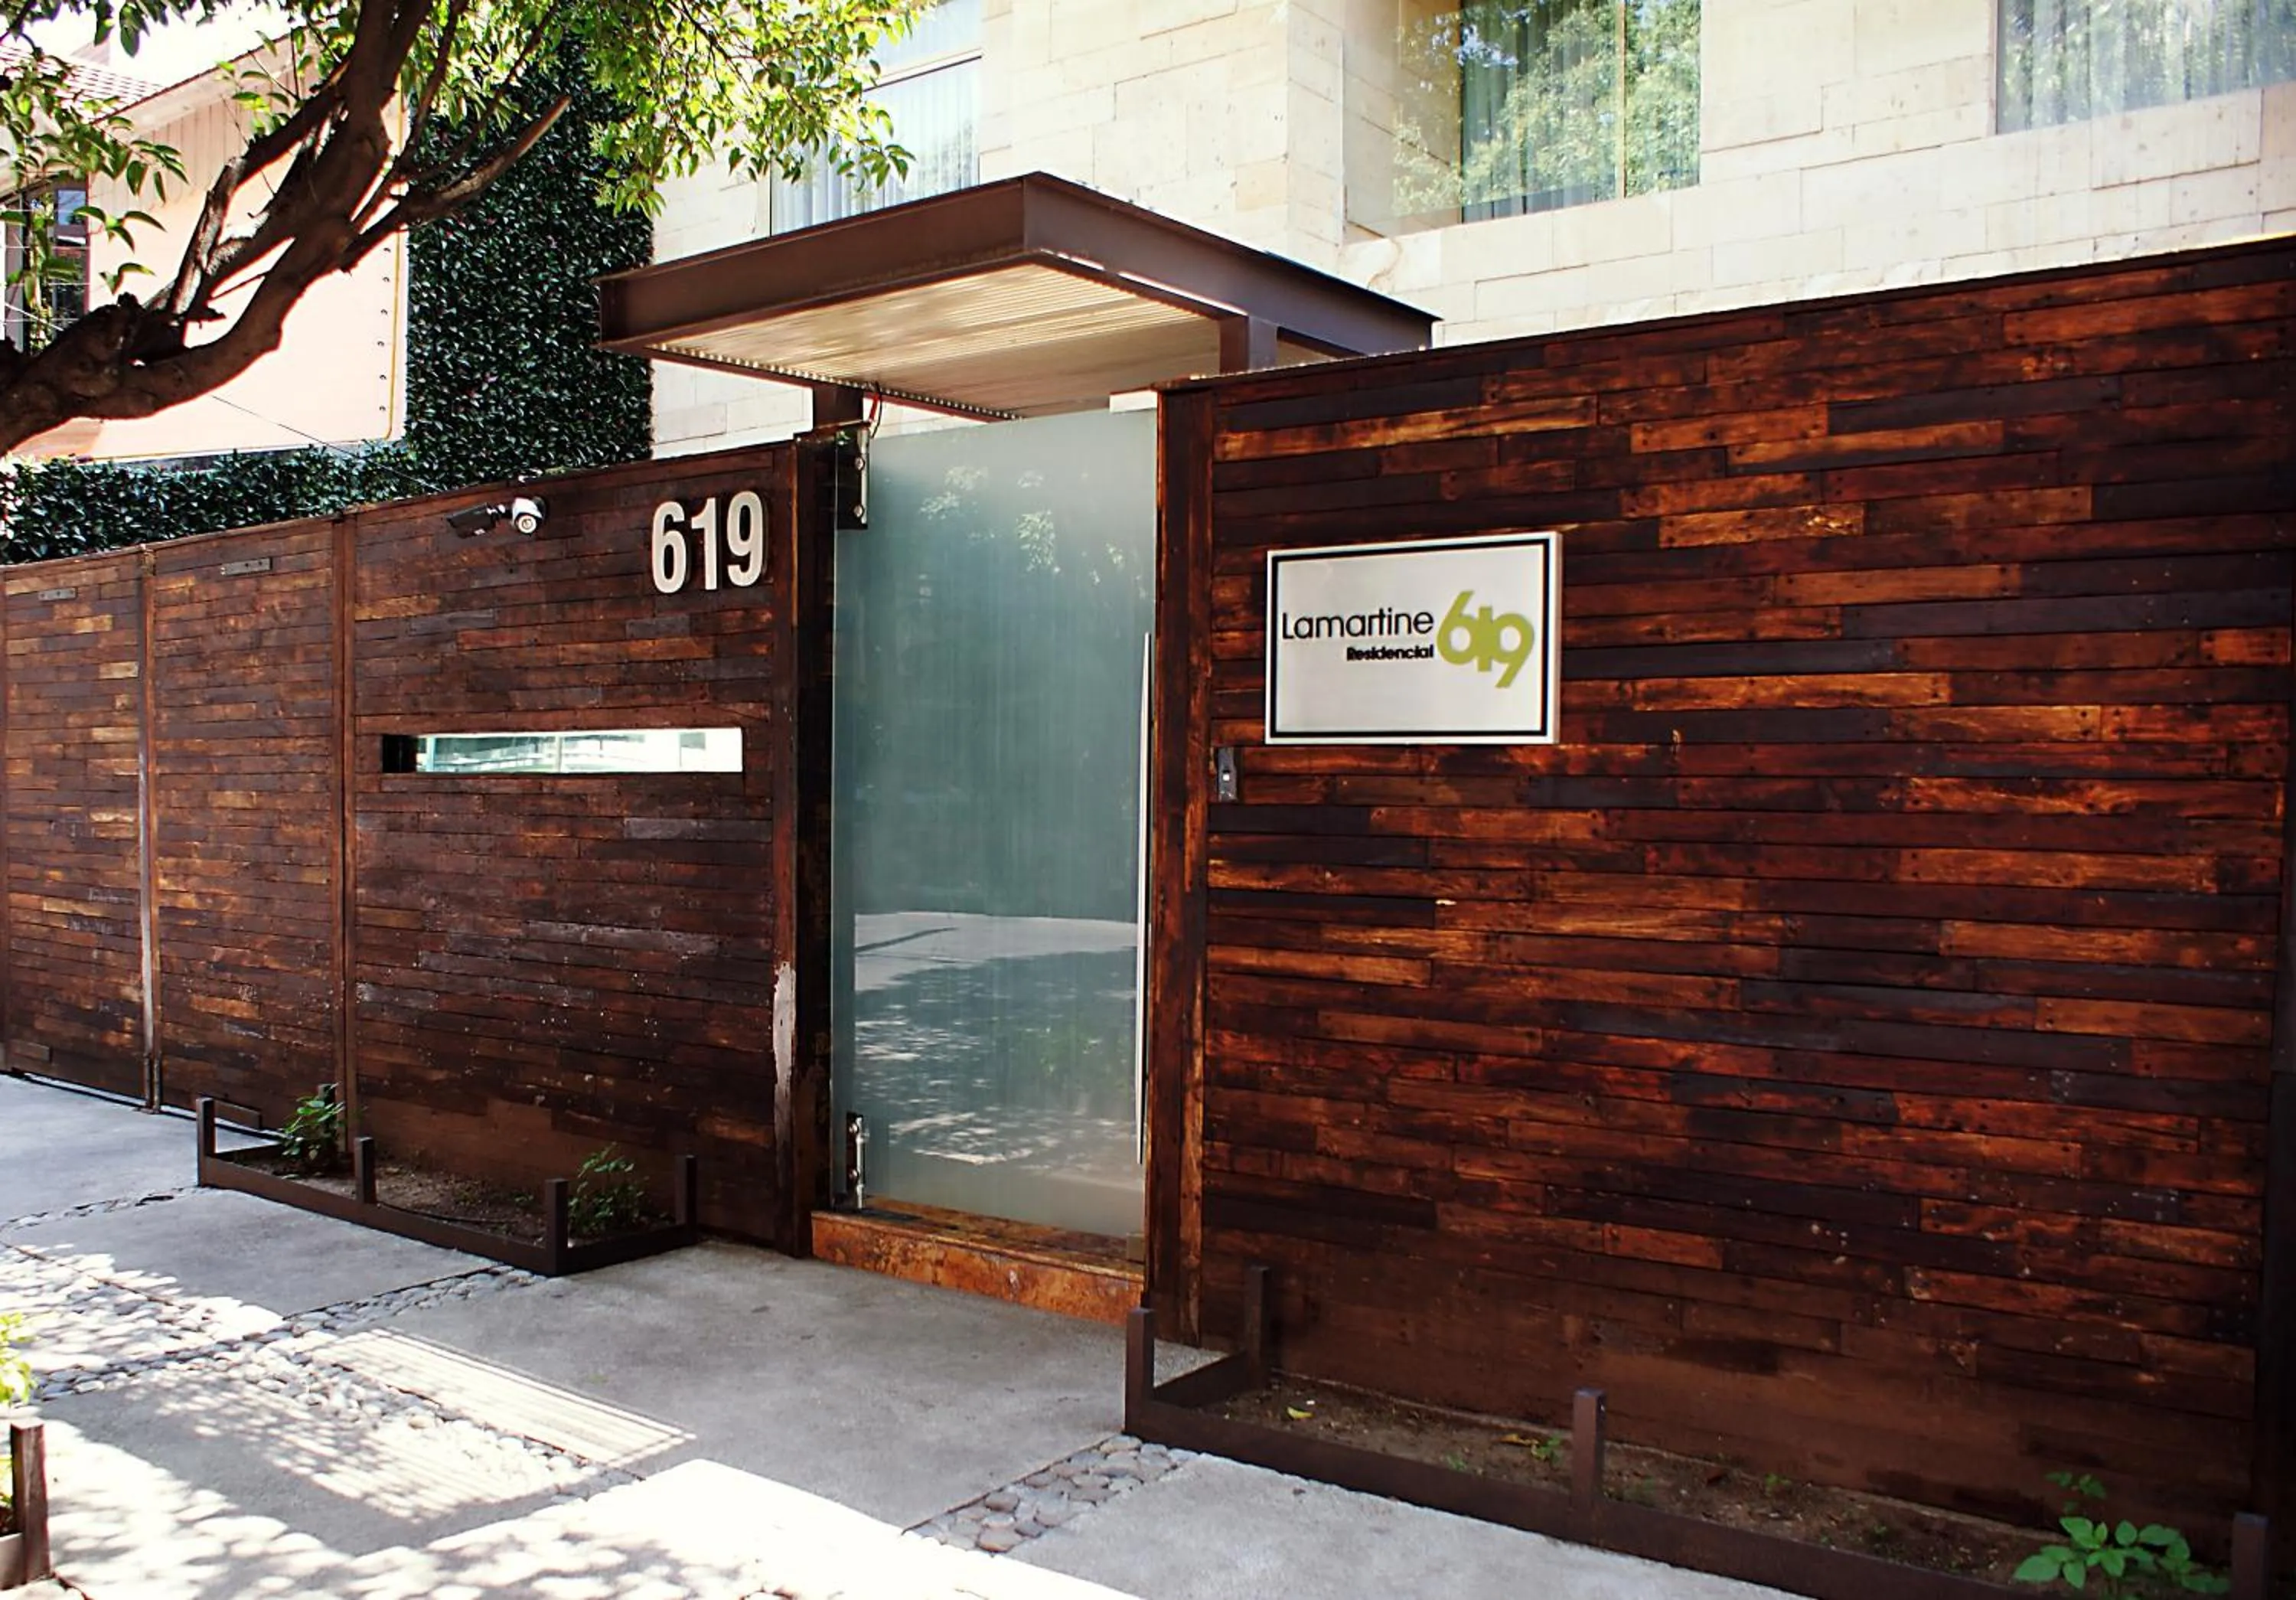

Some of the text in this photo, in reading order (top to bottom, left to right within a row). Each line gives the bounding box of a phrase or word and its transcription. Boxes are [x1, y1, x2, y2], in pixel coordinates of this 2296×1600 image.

[652, 491, 763, 593] 619
[1282, 590, 1534, 688] Lamartine 619
[1346, 644, 1434, 661] Residencial
